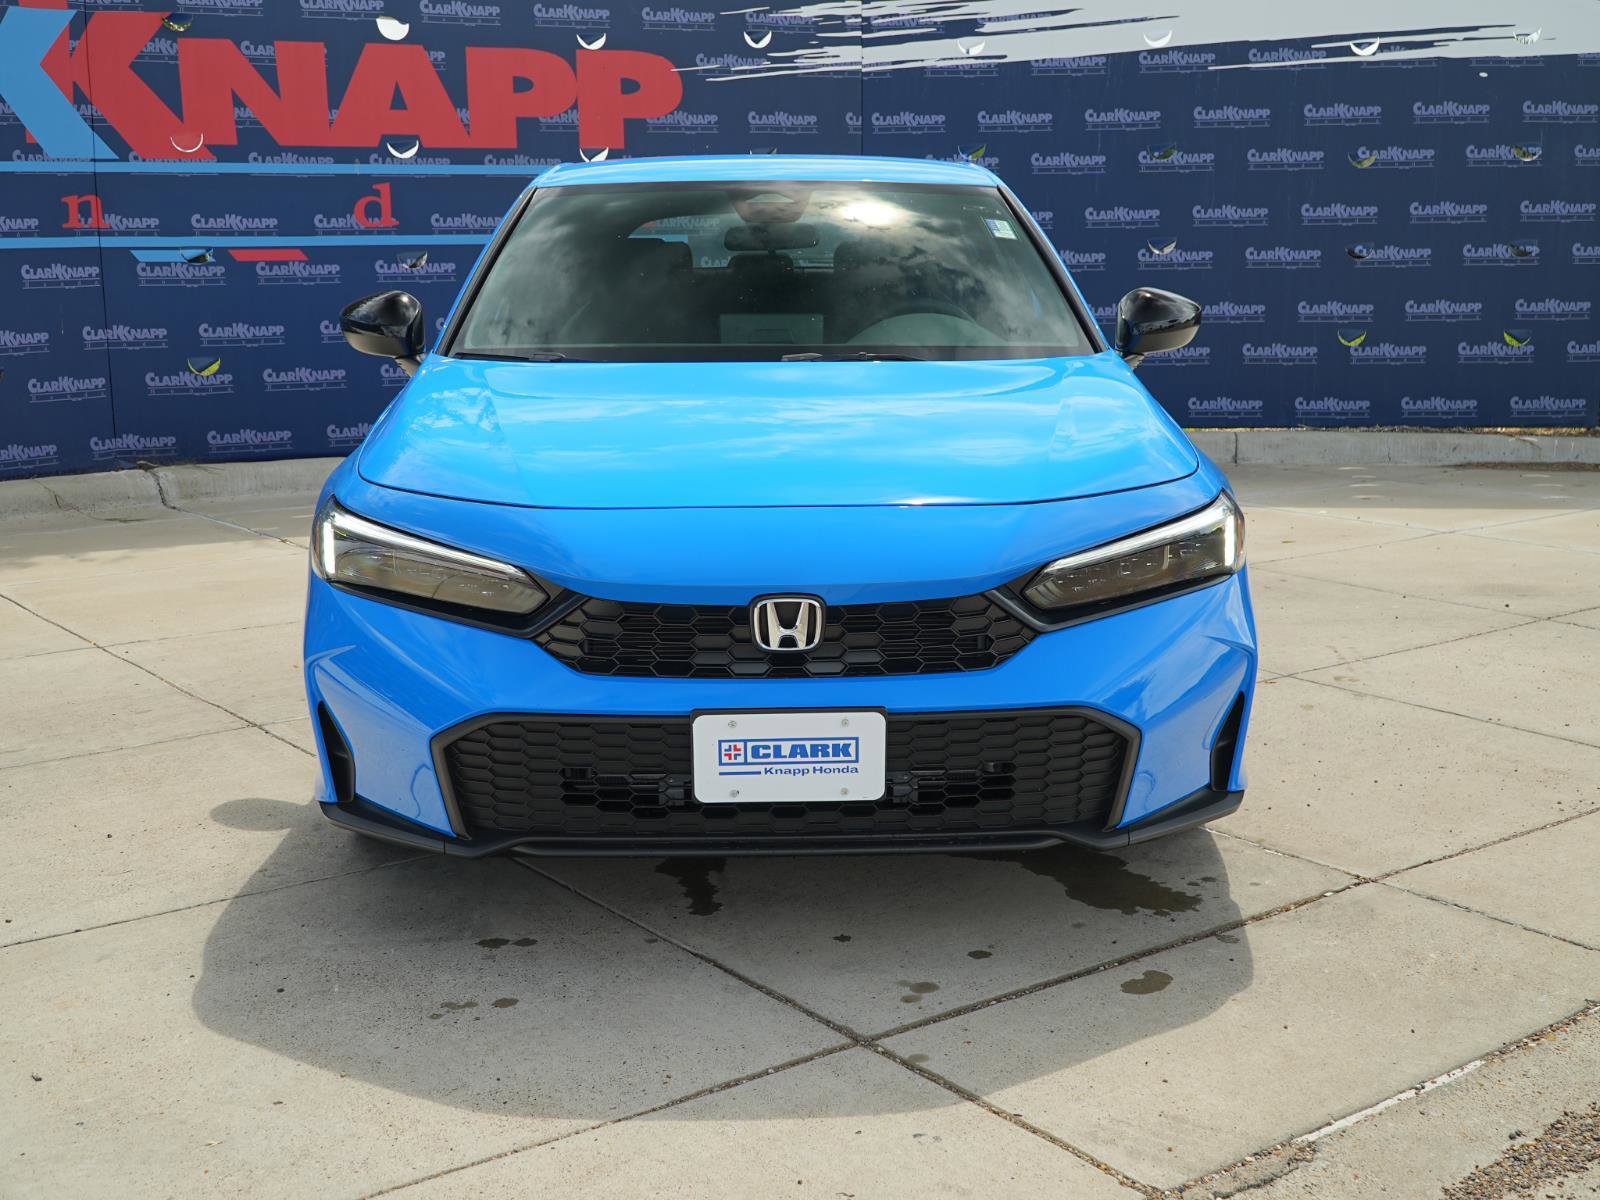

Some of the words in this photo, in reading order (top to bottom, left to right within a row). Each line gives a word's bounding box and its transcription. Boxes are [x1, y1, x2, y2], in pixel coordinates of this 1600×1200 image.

[751, 743, 852, 759] CLARK
[764, 766, 809, 776] Knapp
[812, 765, 859, 775] Honda
